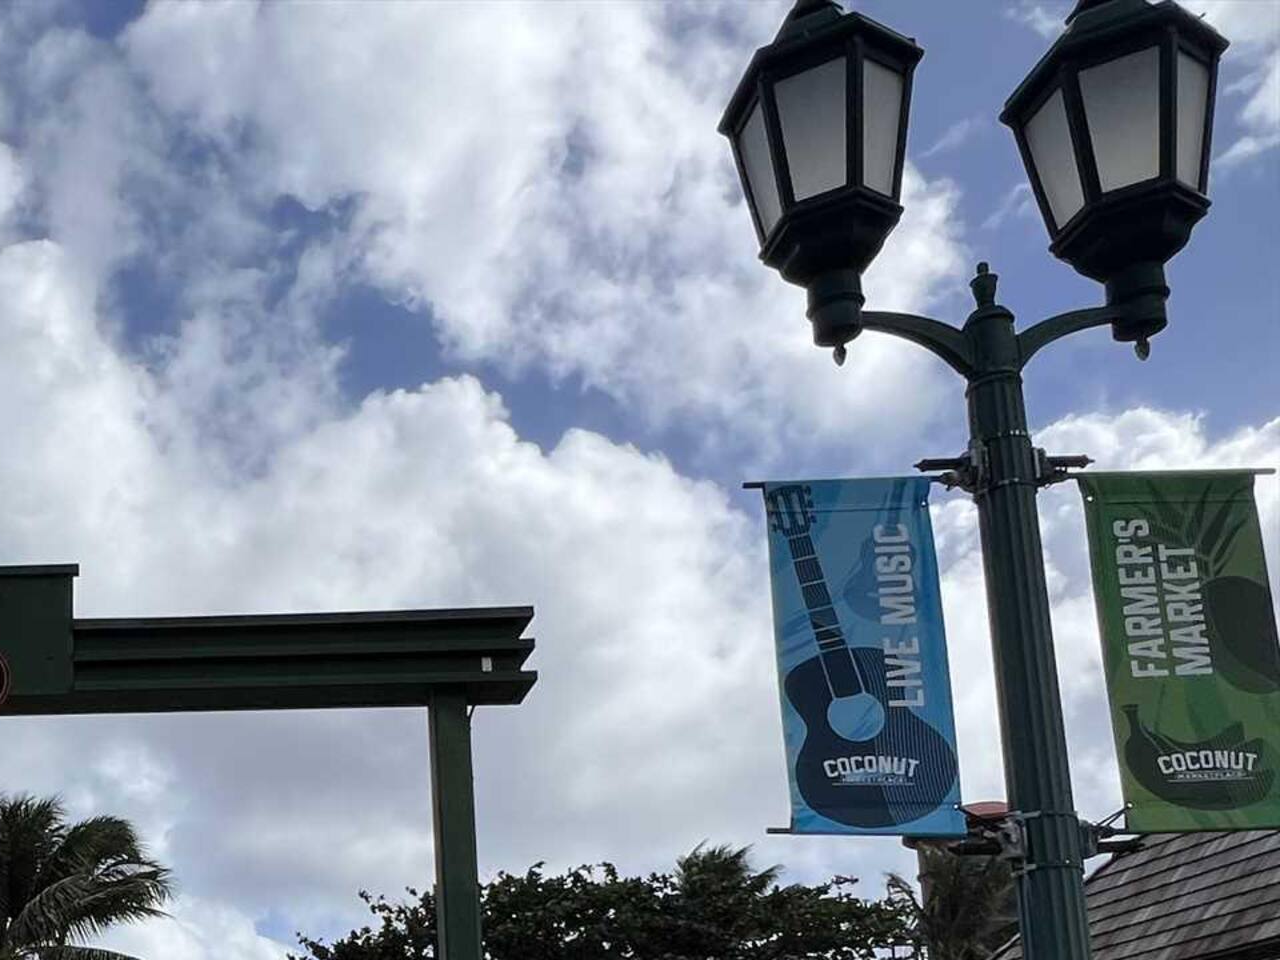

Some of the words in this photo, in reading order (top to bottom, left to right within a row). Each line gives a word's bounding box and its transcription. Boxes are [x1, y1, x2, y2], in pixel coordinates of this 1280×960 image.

[873, 523, 916, 625] MUSIC
[1113, 518, 1170, 679] FARMER'S
[1158, 544, 1214, 676] MARKET
[886, 638, 925, 707] LIVE
[823, 755, 920, 777] COCONUT
[1157, 750, 1257, 774] COCONUT
